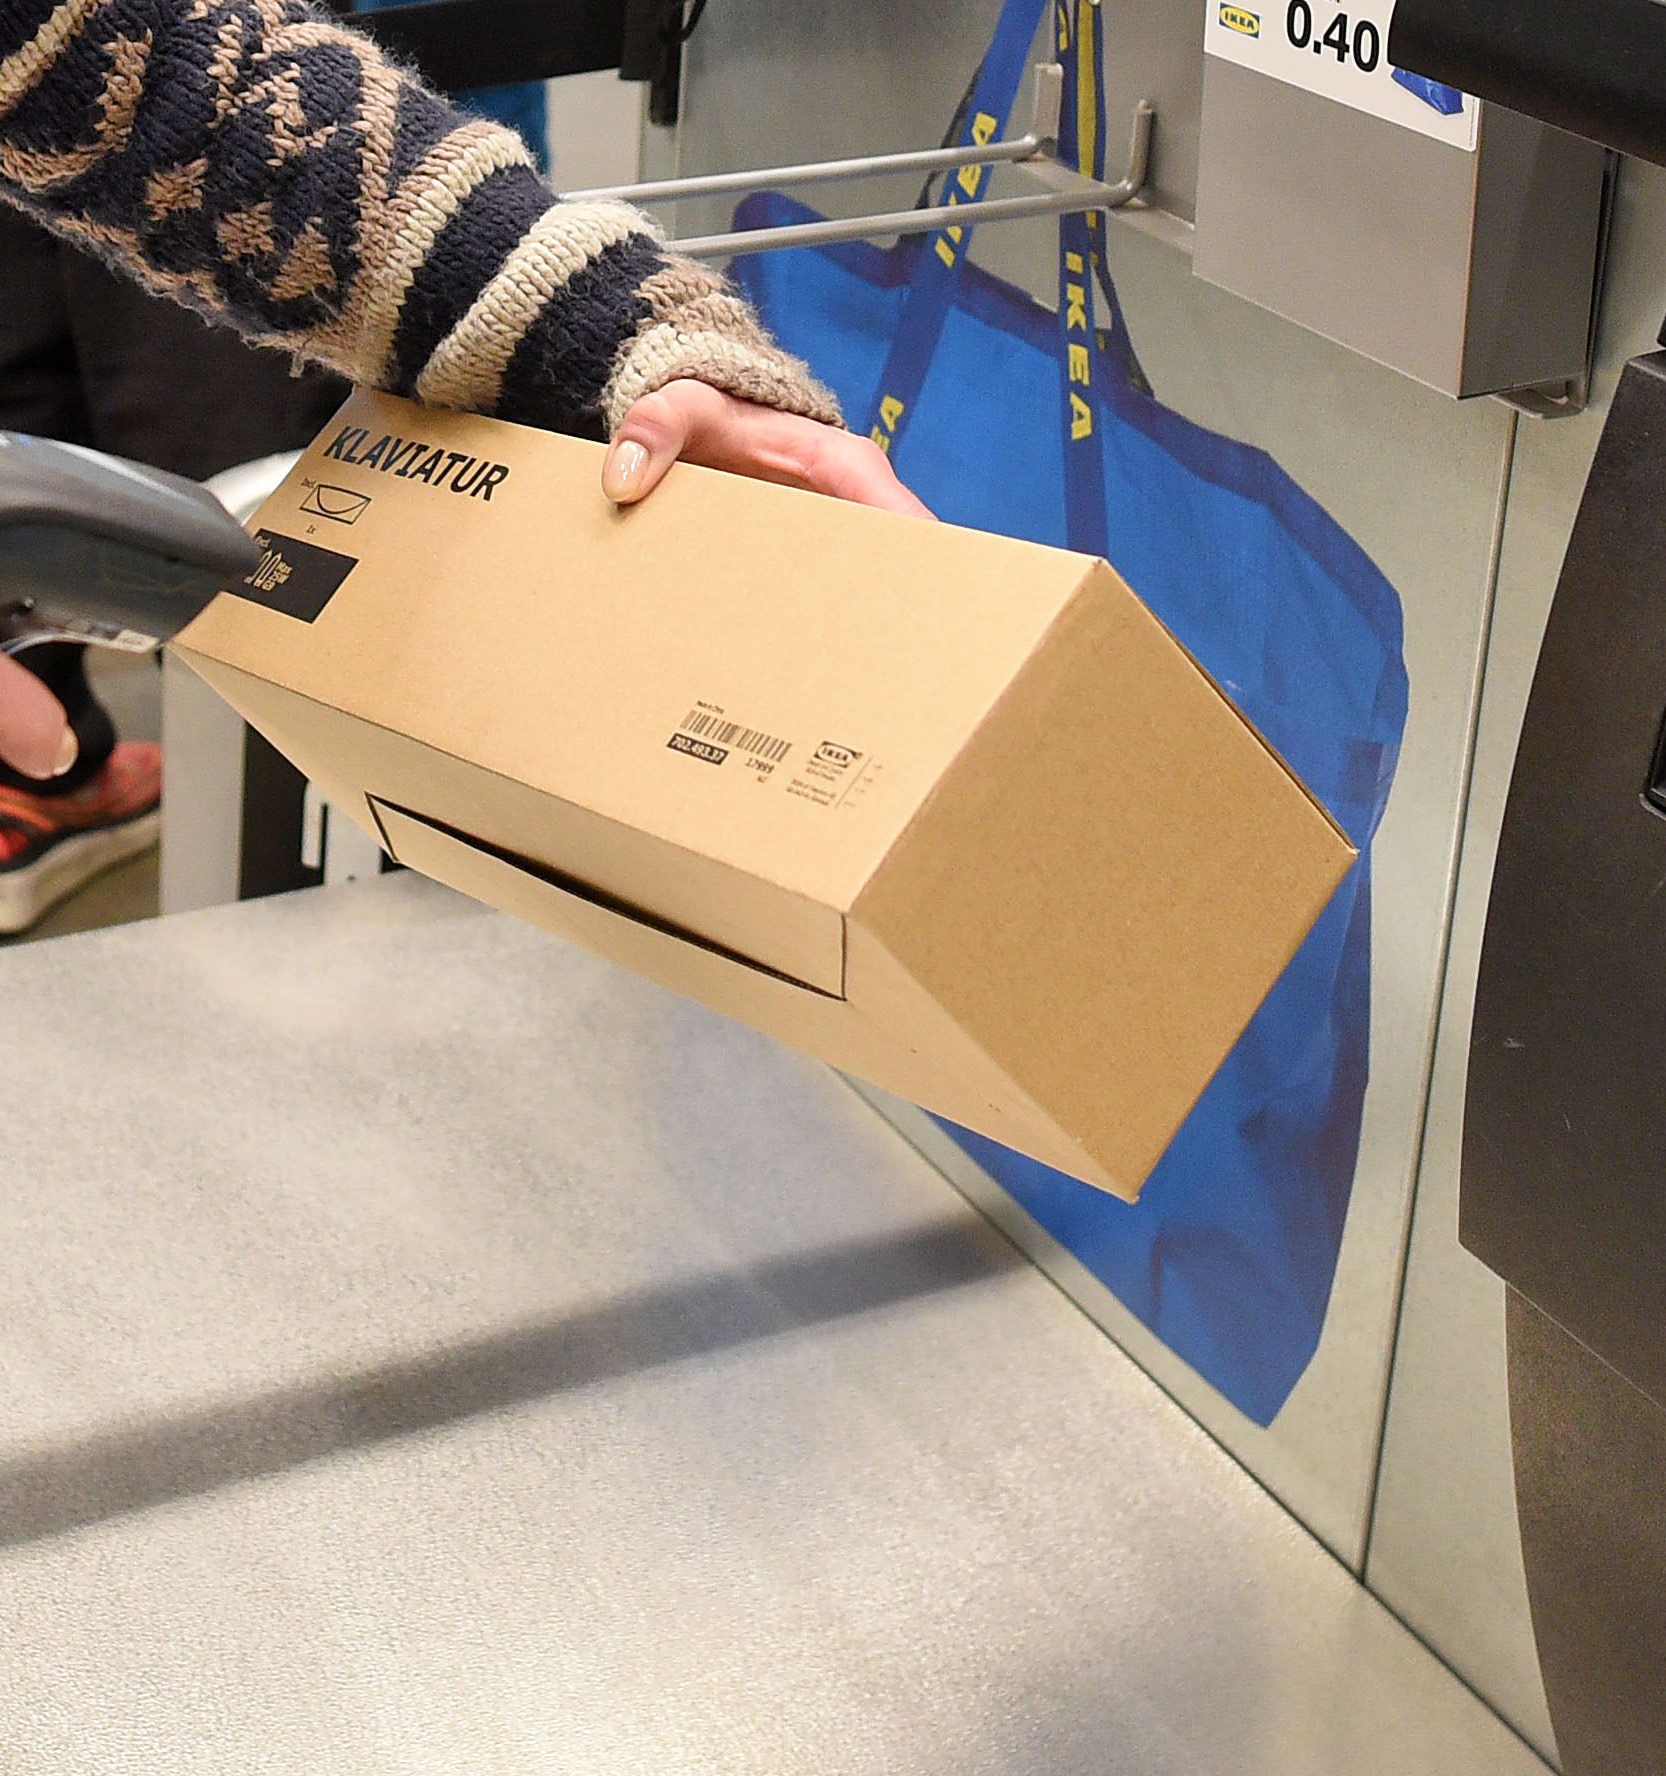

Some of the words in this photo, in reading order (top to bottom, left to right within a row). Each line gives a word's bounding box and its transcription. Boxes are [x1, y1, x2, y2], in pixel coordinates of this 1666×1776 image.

[1225, 11, 1254, 29] IKEA
[1064, 251, 1093, 440] IKEA
[323, 426, 510, 501] KLAVIATUR
